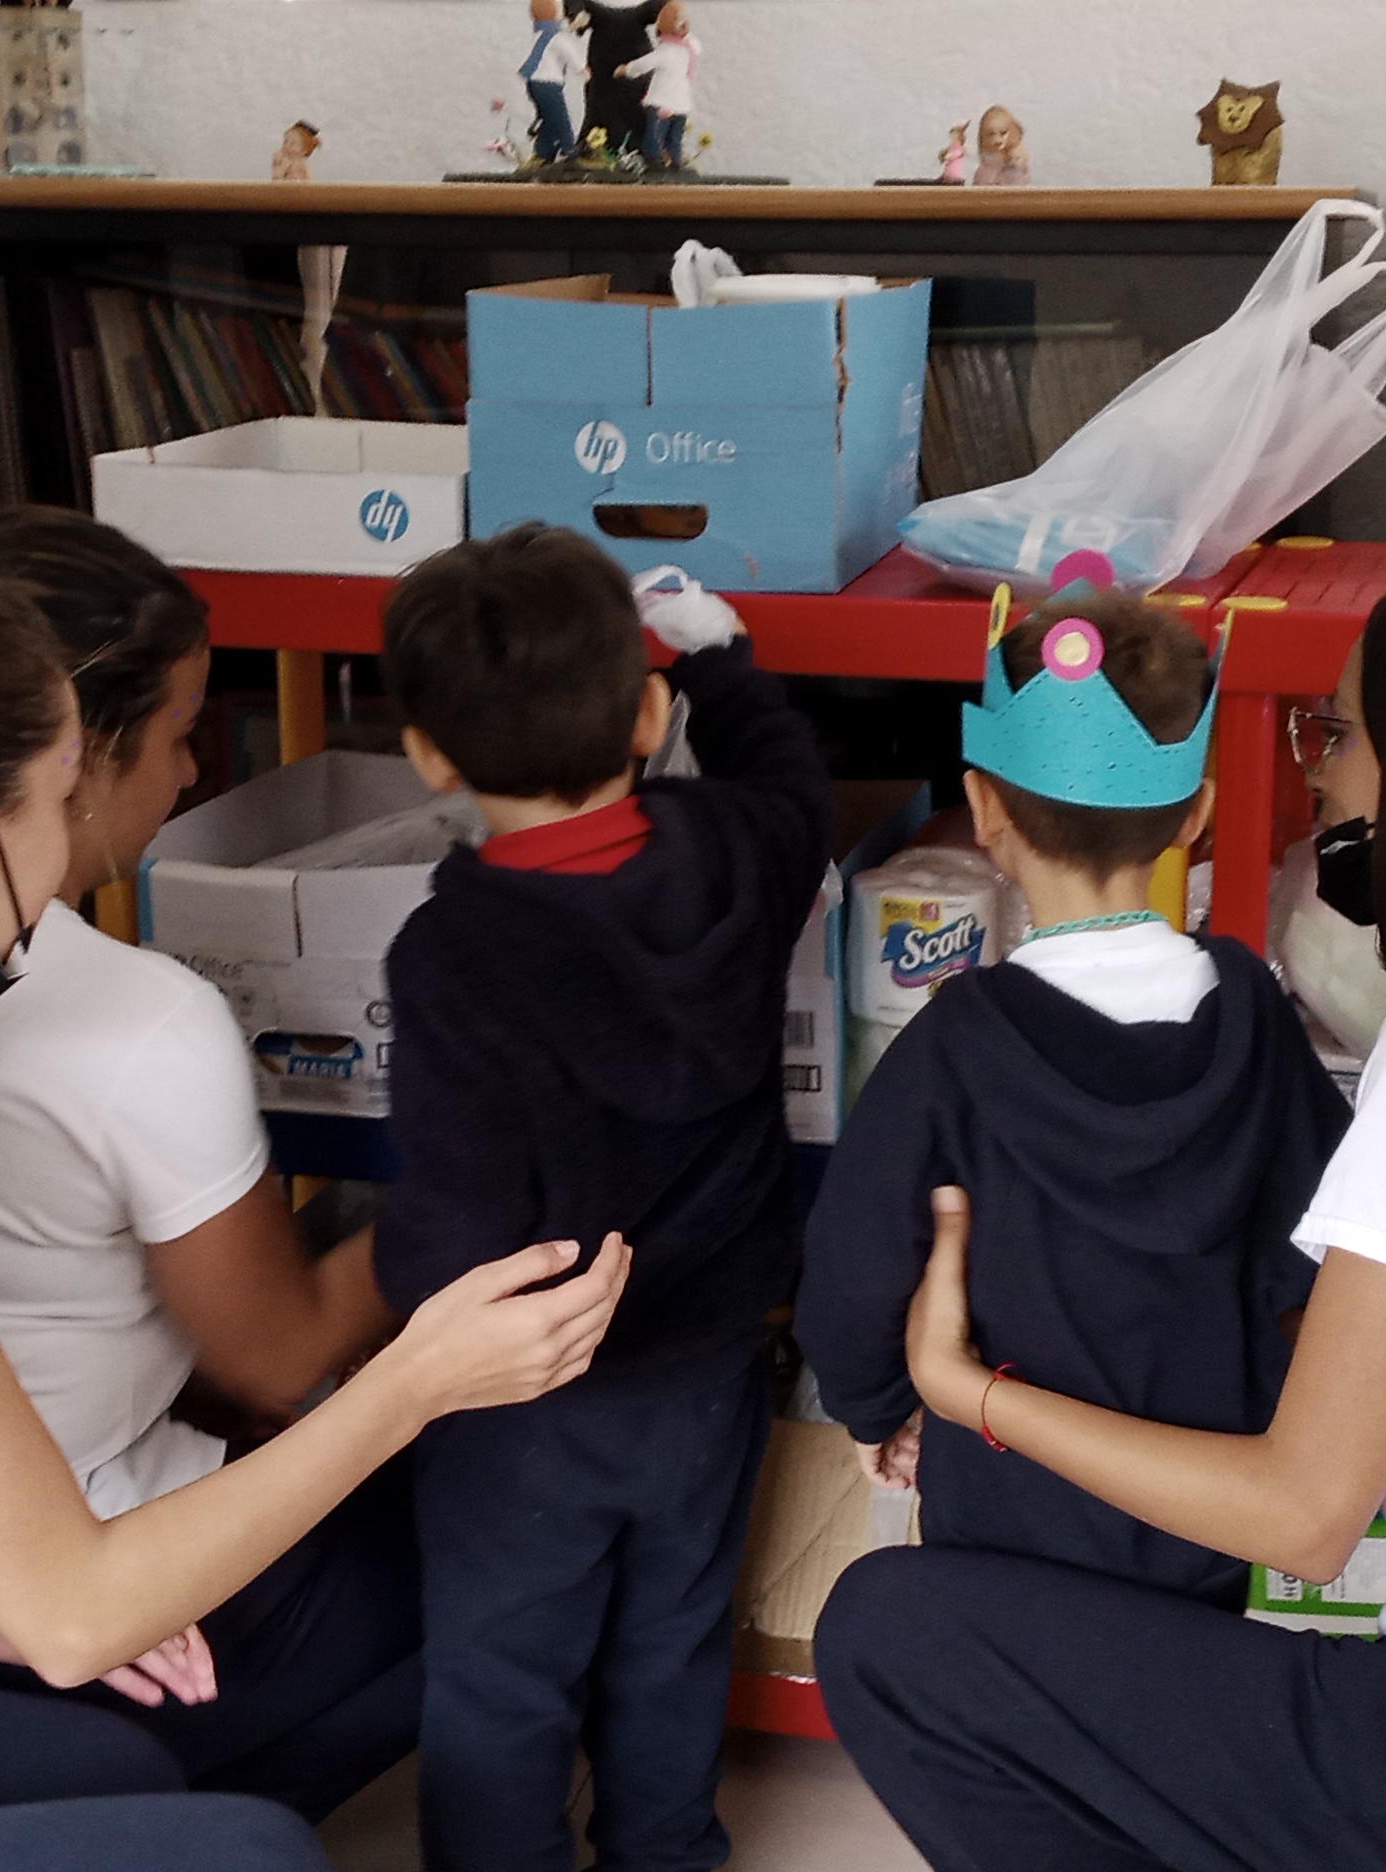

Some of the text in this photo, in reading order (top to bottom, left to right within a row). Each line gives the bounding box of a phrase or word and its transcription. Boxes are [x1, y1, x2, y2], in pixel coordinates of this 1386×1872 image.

[581, 420, 738, 474] hp Office
[899, 914, 975, 970] Scott
